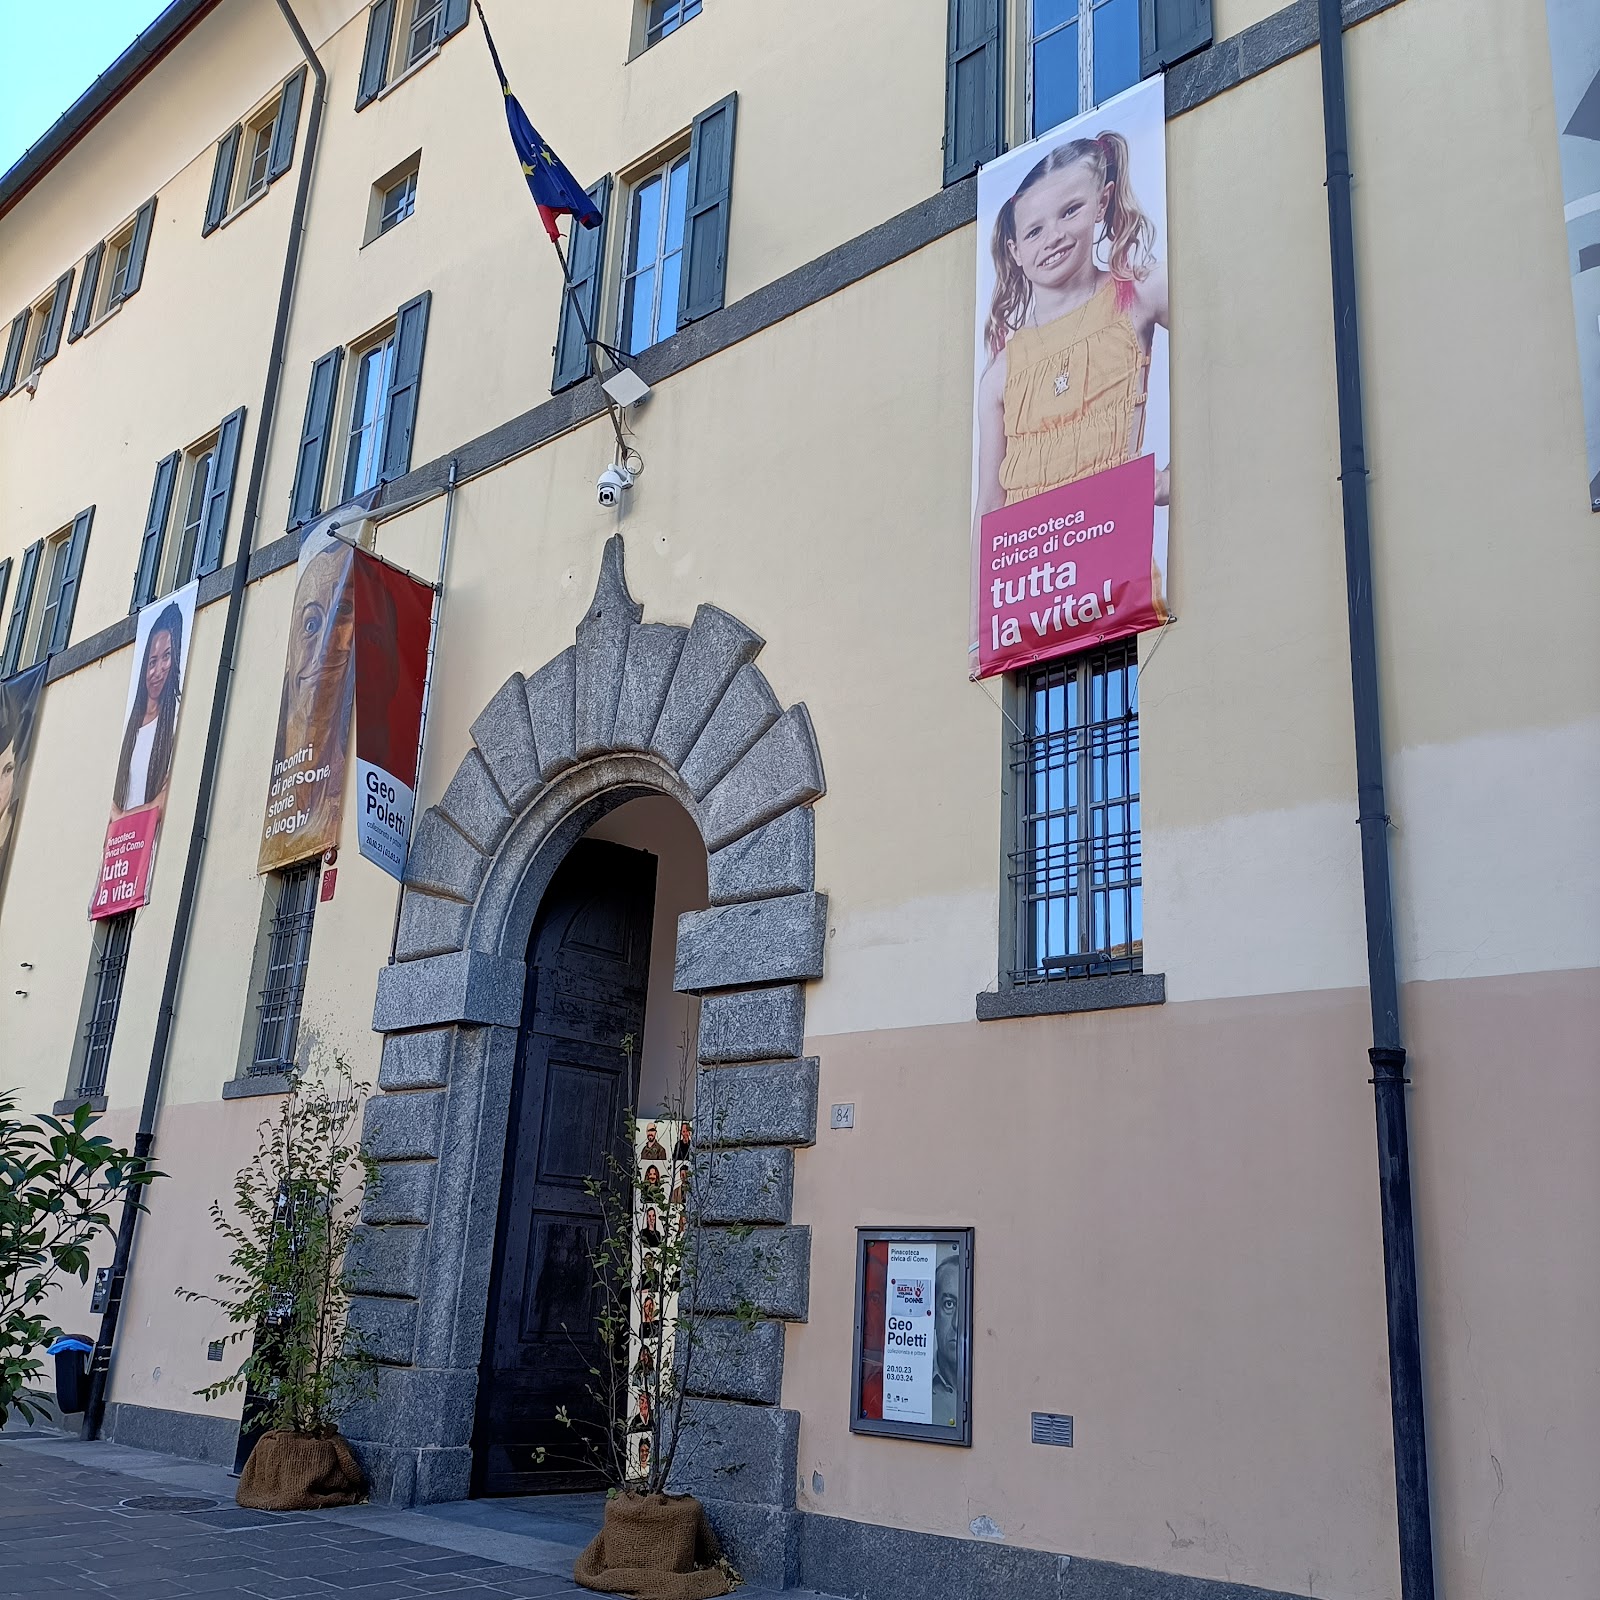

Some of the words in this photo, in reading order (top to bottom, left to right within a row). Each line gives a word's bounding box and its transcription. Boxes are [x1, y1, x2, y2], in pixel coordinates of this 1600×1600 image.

[991, 546, 1038, 571] civica
[1043, 534, 1059, 554] di
[1063, 520, 1115, 547] Como
[992, 510, 1085, 552] Pinacoteca
[990, 561, 1076, 608] tutta
[991, 615, 1022, 651] la
[1030, 579, 1115, 637] vita!
[274, 743, 313, 776] incontri
[271, 777, 281, 797] di
[281, 764, 331, 796] persone,
[366, 771, 395, 803] Geo
[268, 793, 294, 818] storie
[367, 793, 406, 837] Poletti
[265, 825, 272, 839] e
[272, 808, 310, 834] luoghi
[107, 831, 136, 847] Pinacoteca
[120, 843, 126, 854] di
[126, 840, 145, 852] Como
[102, 859, 129, 882] tutta
[96, 885, 108, 906] la
[112, 876, 138, 902] vita!
[836, 1108, 849, 1122] 84
[888, 1317, 913, 1331] Geo
[887, 1332, 927, 1347] Poletti
[886, 1365, 912, 1373] 20.10.23
[886, 1373, 913, 1382] 03.03.24
